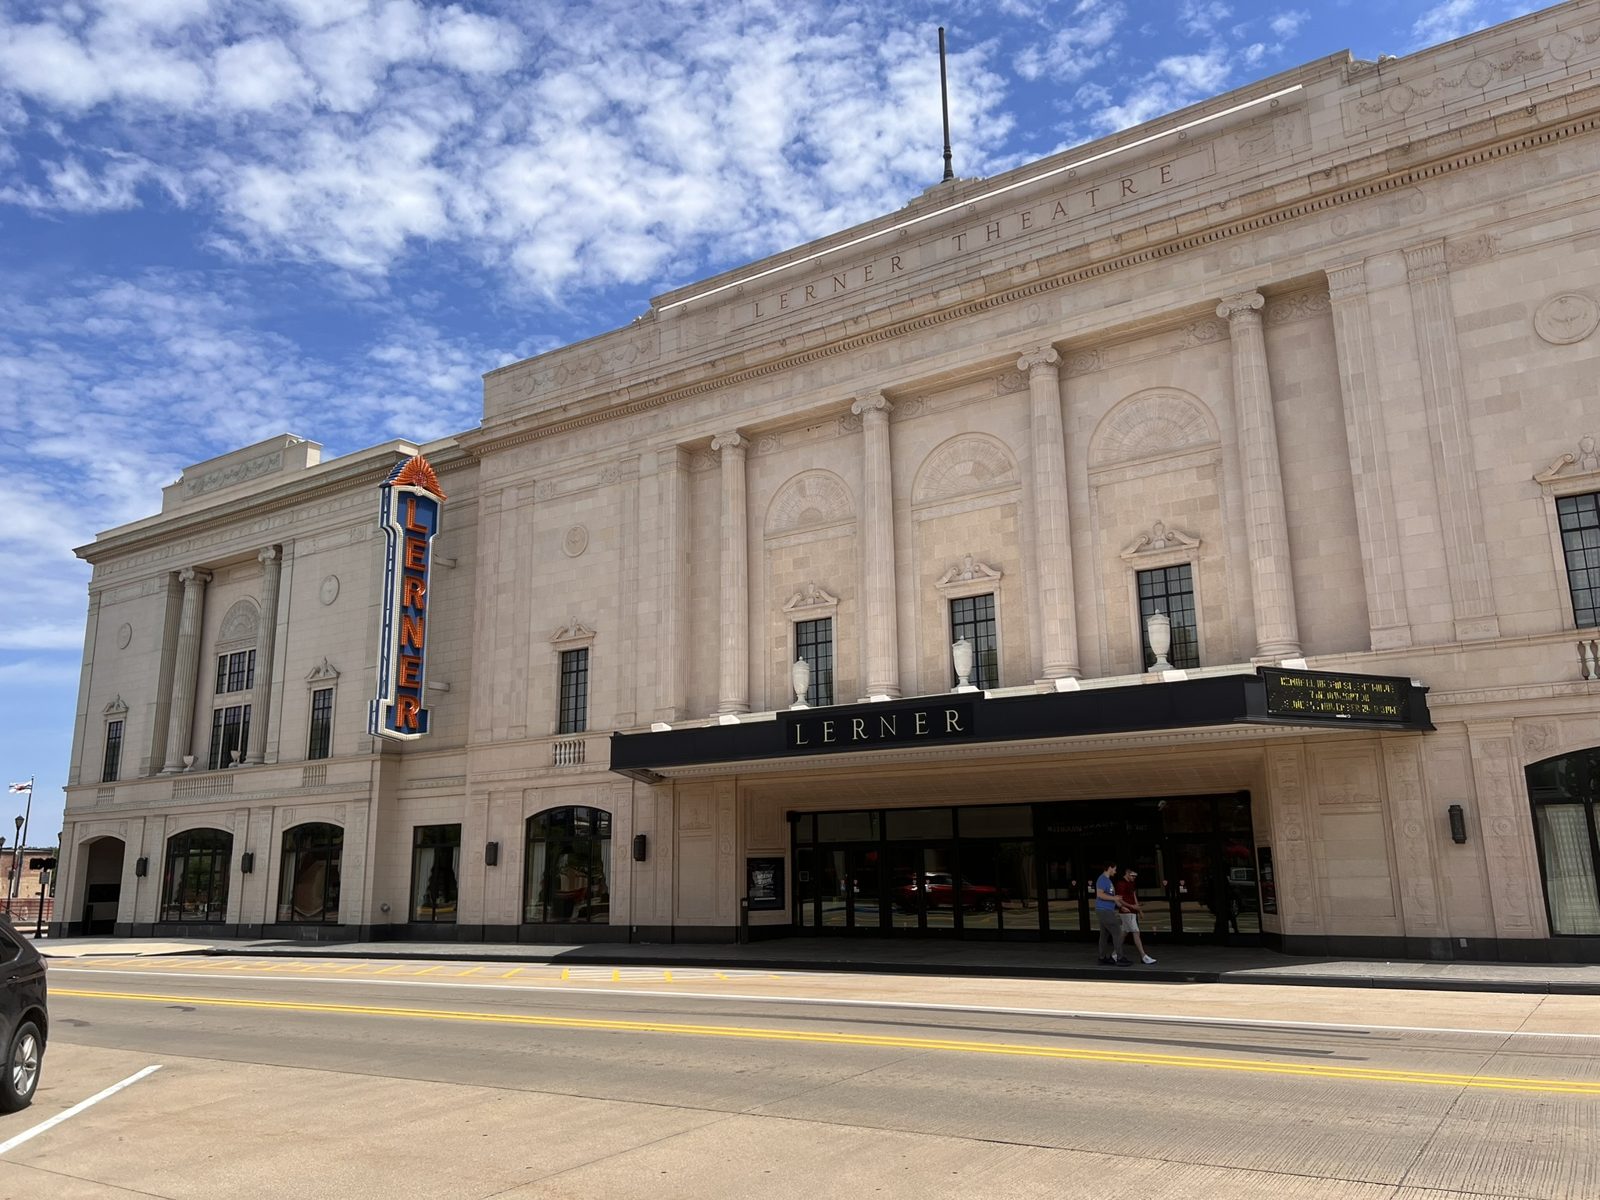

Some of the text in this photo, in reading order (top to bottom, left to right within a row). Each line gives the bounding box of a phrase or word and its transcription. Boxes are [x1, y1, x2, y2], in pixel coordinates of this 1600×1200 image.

[753, 163, 1176, 319] LERNER THEATRE
[394, 498, 429, 730] LERNER
[795, 708, 964, 745] LERNER
